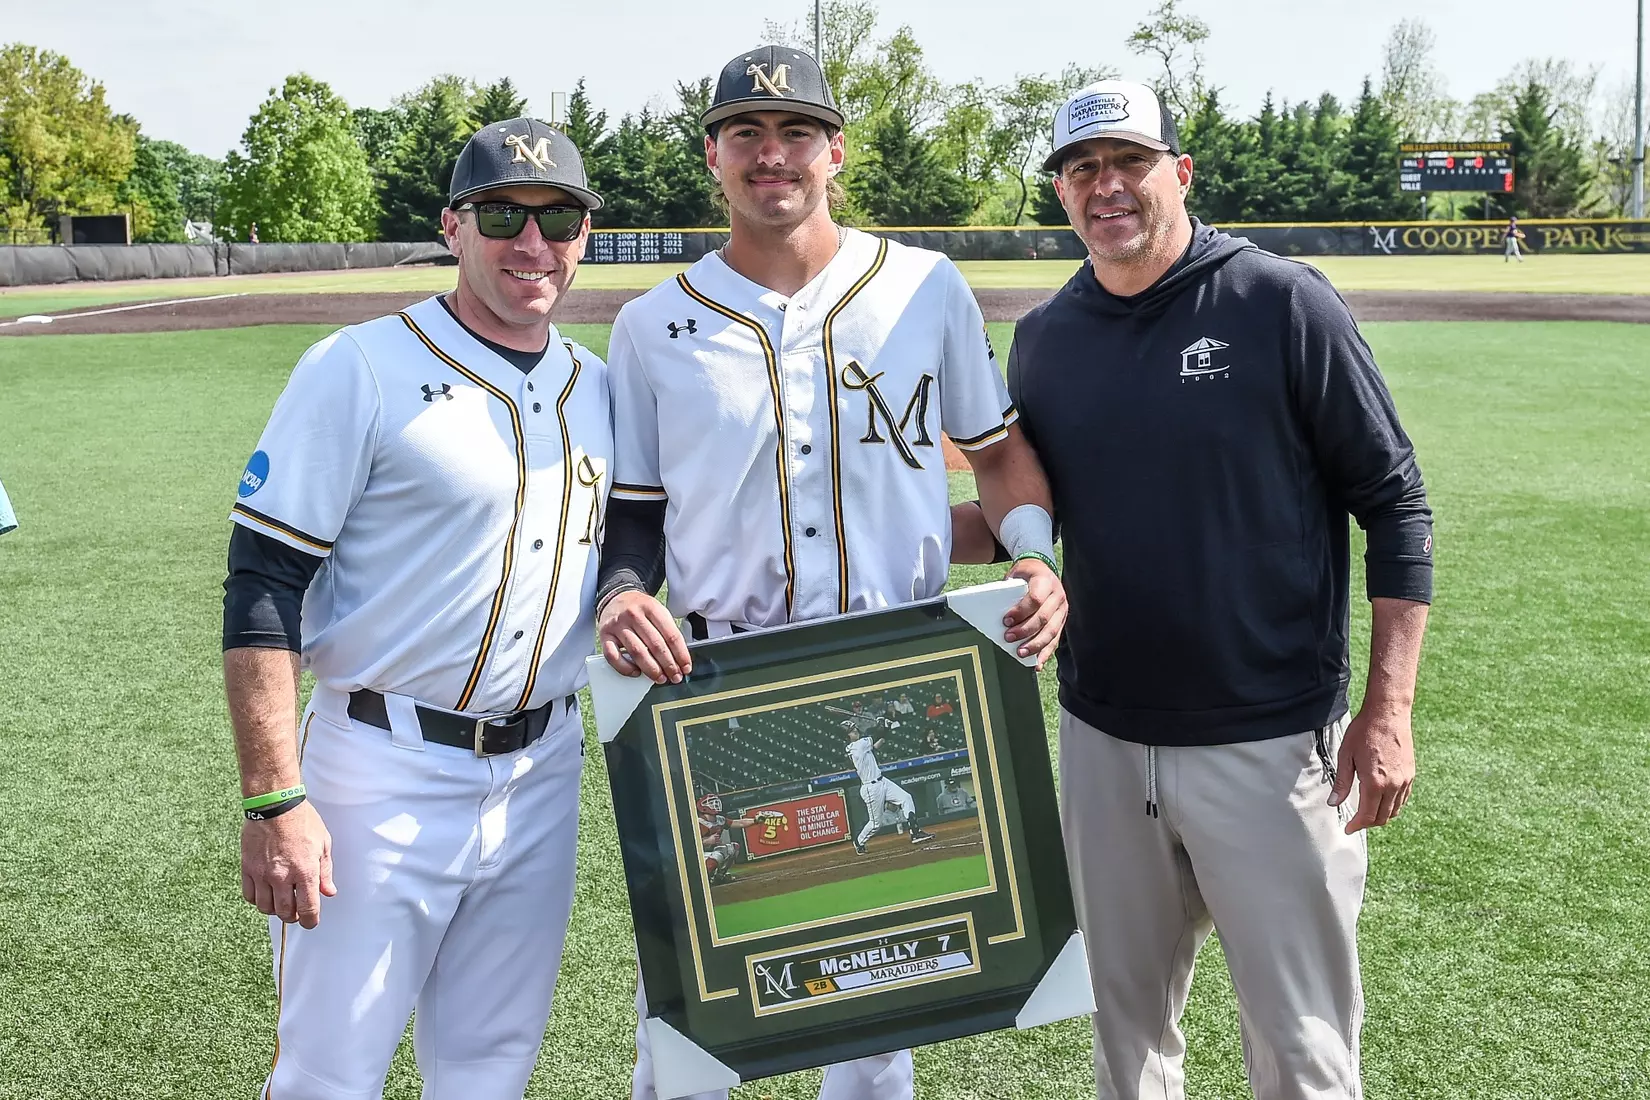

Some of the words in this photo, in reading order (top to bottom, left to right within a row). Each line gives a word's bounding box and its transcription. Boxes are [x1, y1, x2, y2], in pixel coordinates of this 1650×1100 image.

[1071, 102, 1121, 120] MARAUDERS
[1074, 98, 1115, 111] MILLERSVILLE
[1078, 110, 1113, 121] BASEBALL
[1400, 182, 1421, 191] VILLE
[1537, 227, 1635, 251] PARK
[241, 468, 262, 491] NCAA
[796, 808, 810, 817] THE
[810, 804, 827, 814] STAY
[764, 817, 781, 826] AKE
[798, 817, 806, 825] IN
[807, 813, 826, 823] YOUR
[826, 810, 840, 819] CAR
[807, 820, 834, 831] MINUTE
[763, 826, 777, 839] 5
[800, 832, 811, 840] OIL
[819, 941, 919, 976] McNELLY
[938, 935, 951, 952] 7
[813, 980, 828, 992] 2B
[869, 958, 940, 981] MARAUDERS
